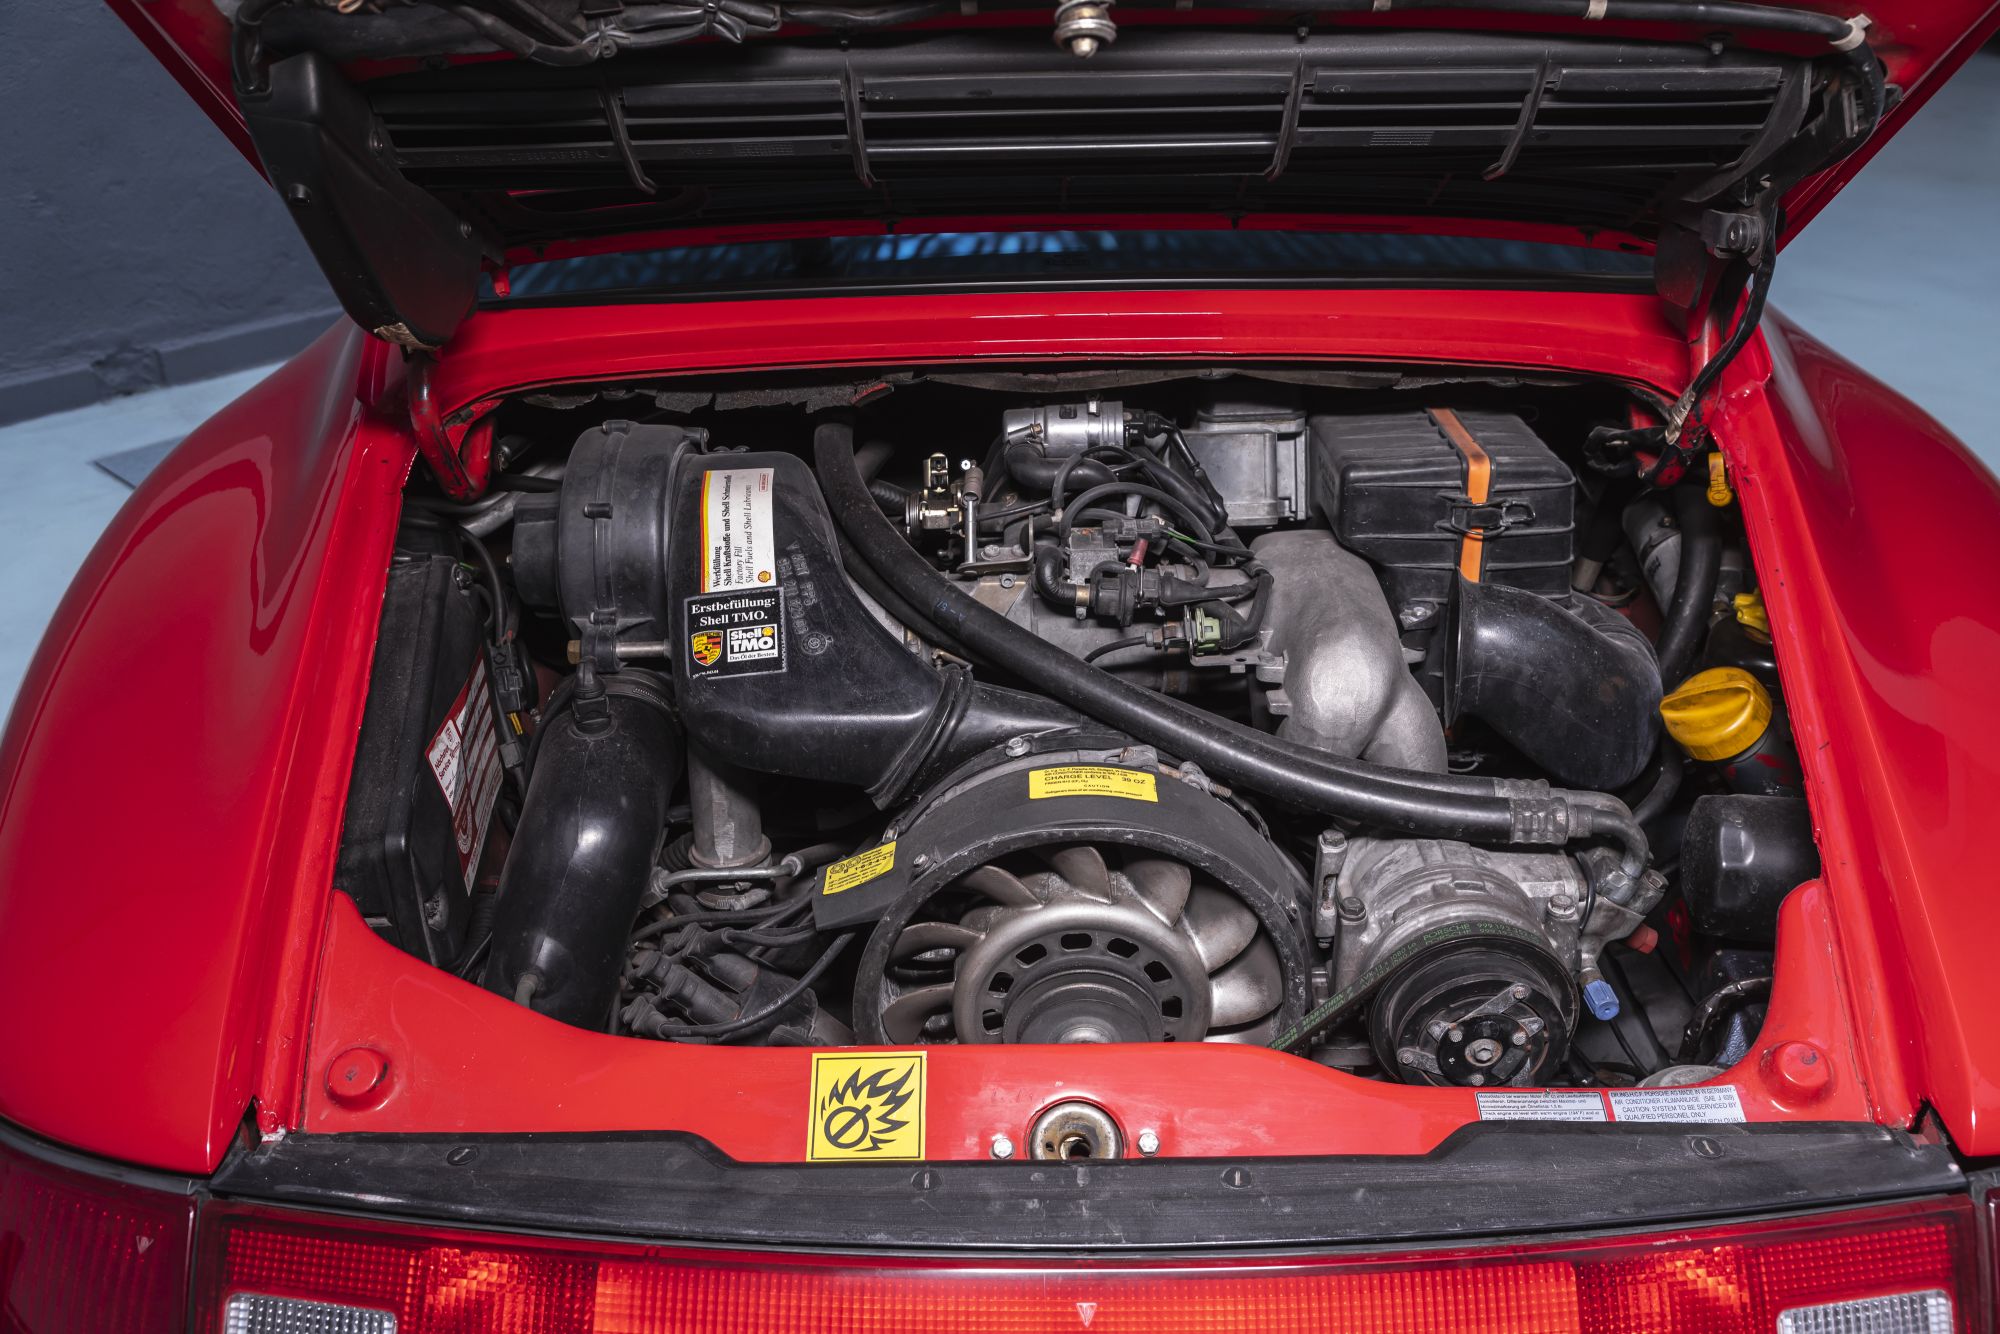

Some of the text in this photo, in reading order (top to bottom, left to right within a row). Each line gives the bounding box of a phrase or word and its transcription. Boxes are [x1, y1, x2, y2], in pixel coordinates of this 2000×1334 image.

[722, 501, 730, 516] Shell
[744, 513, 752, 529] Shell
[744, 532, 752, 544] and
[723, 533, 731, 566] Kraftstoffe
[745, 546, 753, 564] Fuels
[713, 546, 722, 587] Werkfüllung
[734, 546, 744, 584] Factory Fill
[724, 569, 732, 586] Shell
[746, 566, 754, 583] Shell
[691, 598, 775, 614] Erstbefüllung:
[700, 611, 768, 627] Shell TMO.
[731, 629, 762, 640] Shell
[731, 637, 774, 652] TMO
[1424, 923, 1470, 940] PORSCHE
[1652, 1104, 1678, 1112] SYSTEM
